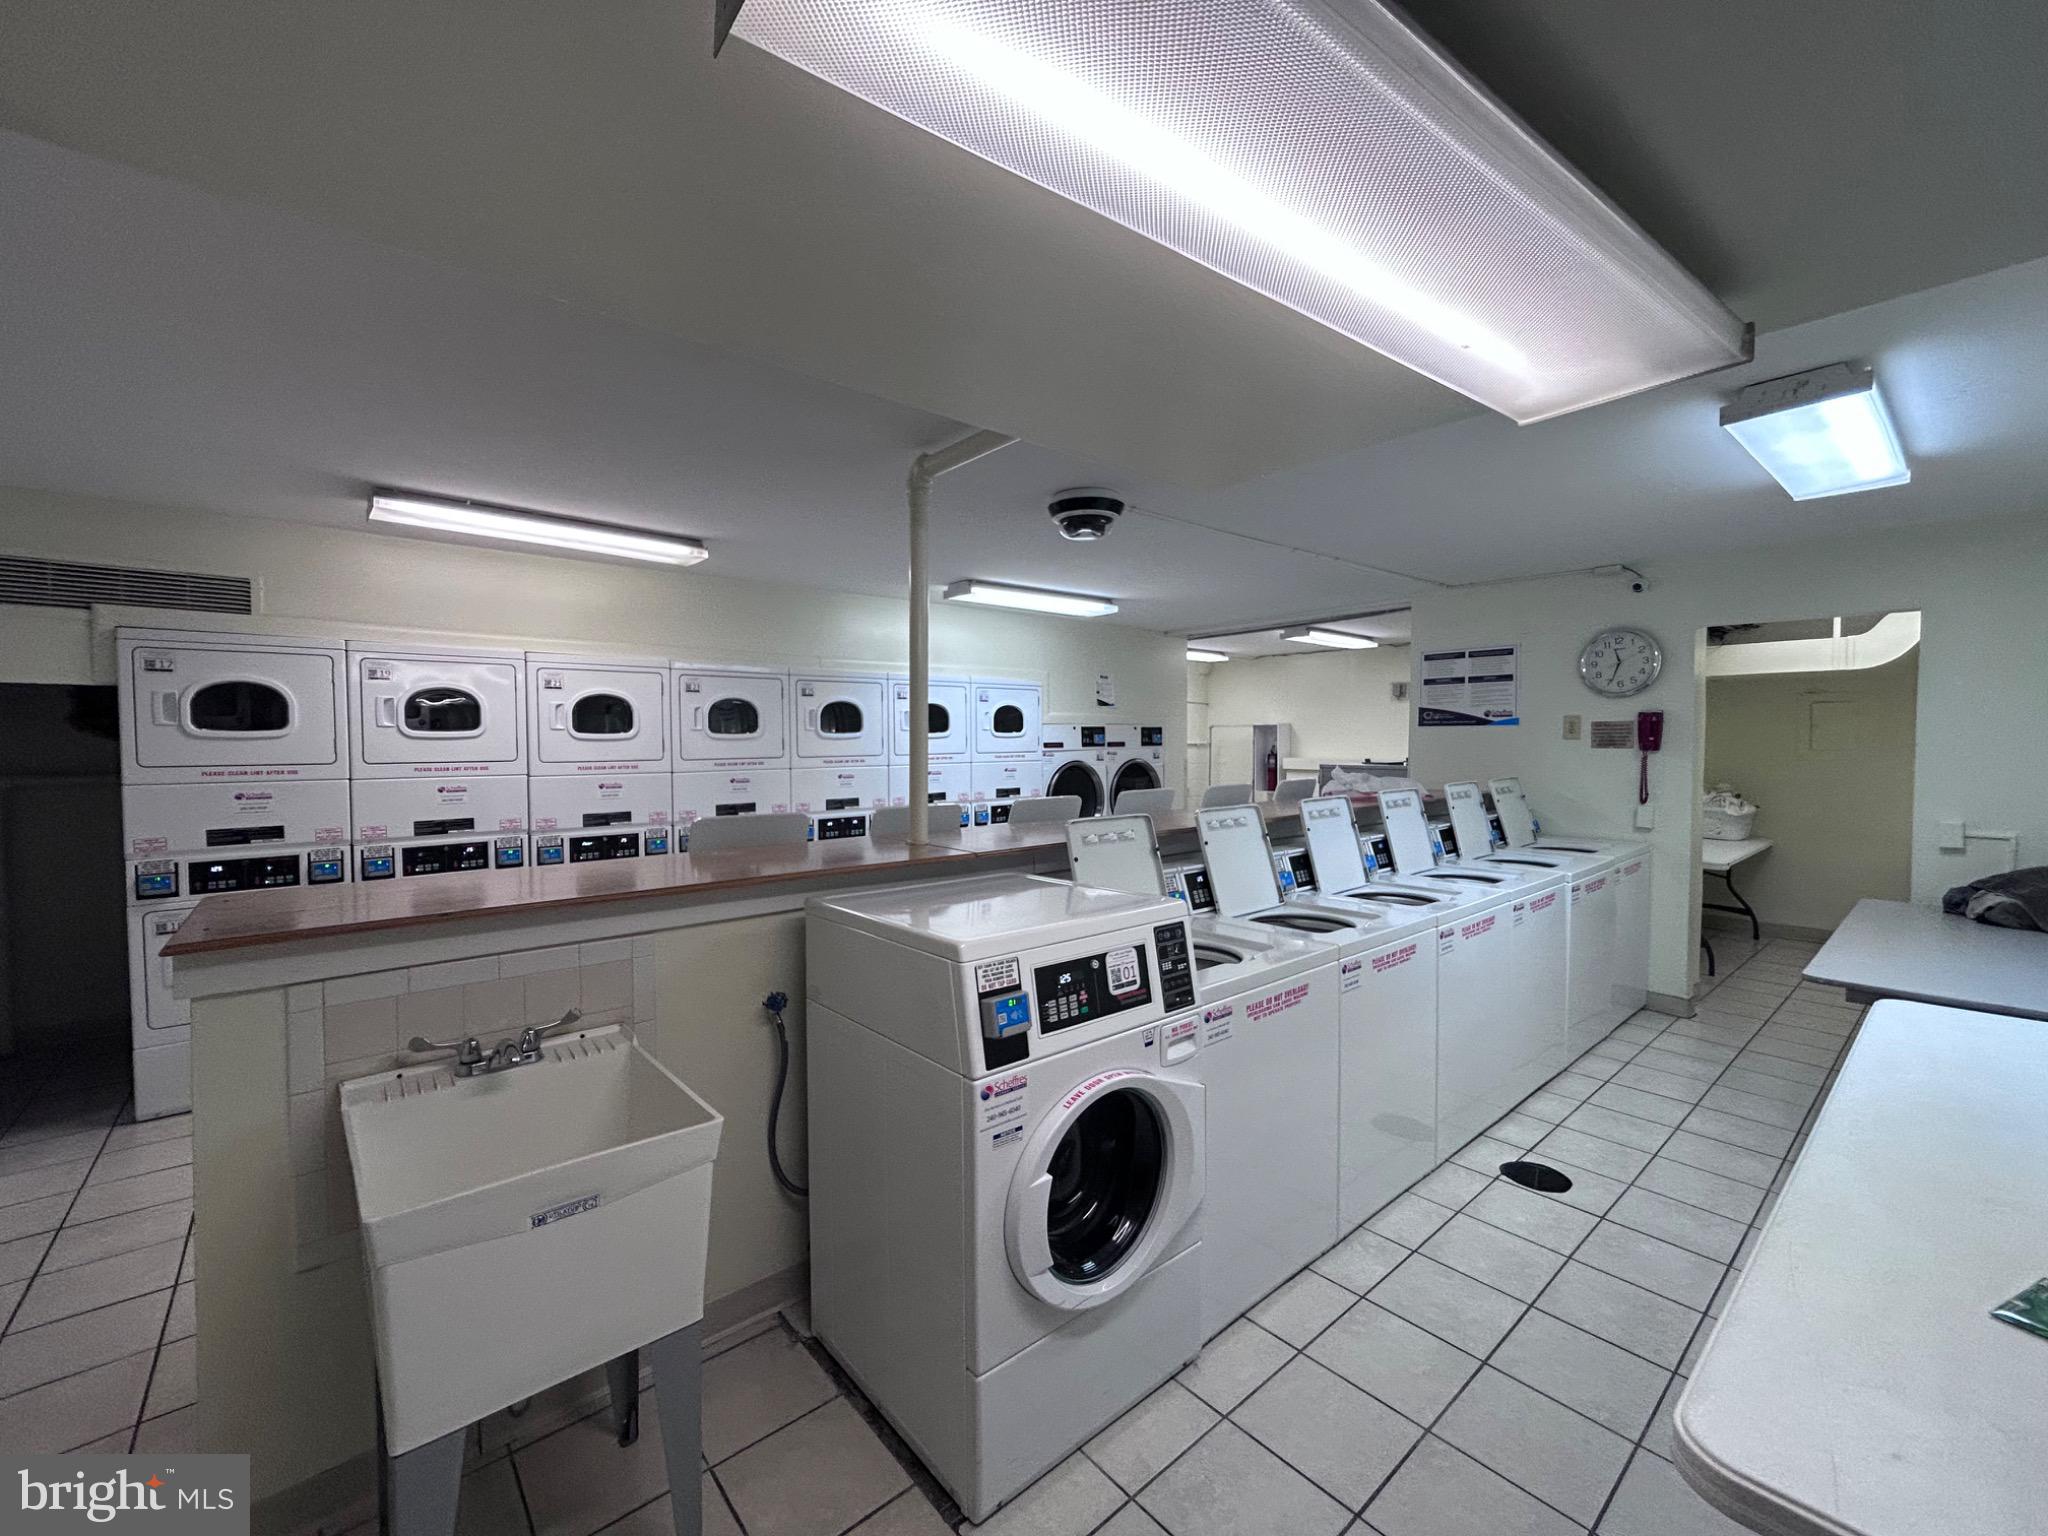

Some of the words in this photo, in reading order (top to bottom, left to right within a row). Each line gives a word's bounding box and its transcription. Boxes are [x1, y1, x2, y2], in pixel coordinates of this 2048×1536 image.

[1604, 641, 1611, 649] 11
[1643, 656, 1650, 664] 3
[1596, 671, 1602, 679] 8
[1617, 680, 1624, 688] 6
[1630, 676, 1637, 684] 5
[1123, 965, 1137, 980] 01
[1246, 1000, 1264, 1012] PLEASE
[1266, 996, 1272, 1005] DO
[1274, 992, 1282, 1002] NOT
[994, 1075, 1028, 1091] Scheffres
[1063, 1090, 1085, 1109] LEAVE
[1084, 1079, 1105, 1090] DOOR
